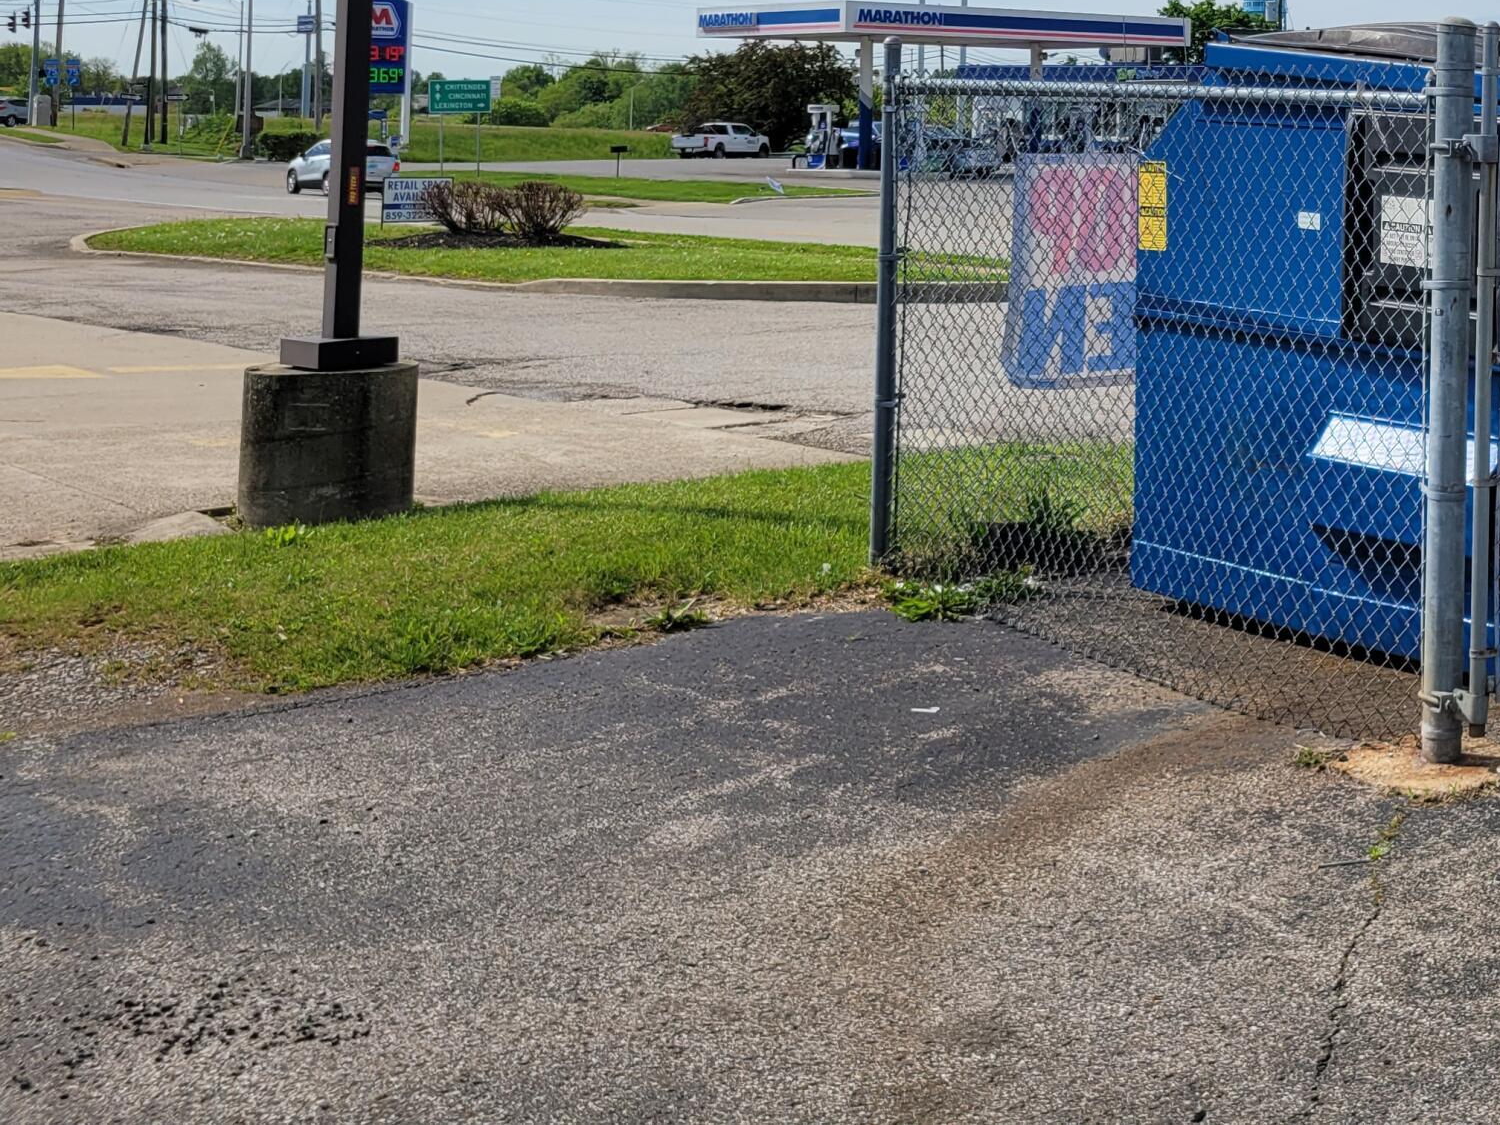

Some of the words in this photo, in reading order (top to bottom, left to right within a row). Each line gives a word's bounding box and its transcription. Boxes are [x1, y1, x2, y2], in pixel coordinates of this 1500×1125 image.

[699, 12, 752, 28] MARATHON
[858, 8, 944, 26] MARATHON
[444, 83, 487, 91] CRITTENDEN
[387, 180, 418, 190] RETAIL
